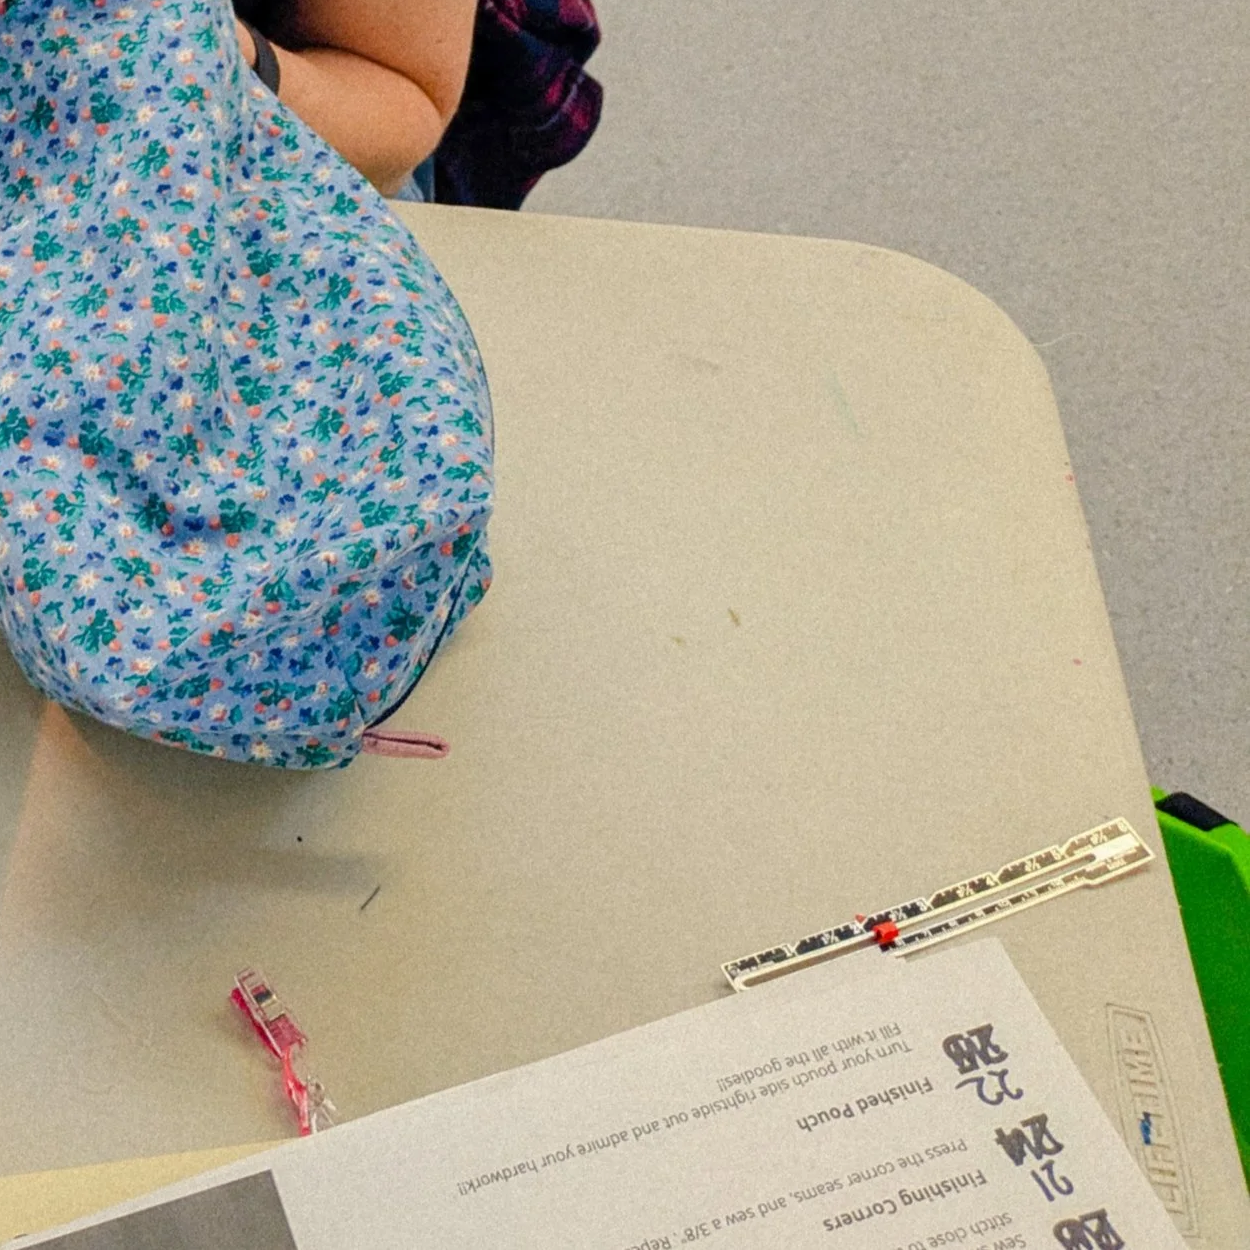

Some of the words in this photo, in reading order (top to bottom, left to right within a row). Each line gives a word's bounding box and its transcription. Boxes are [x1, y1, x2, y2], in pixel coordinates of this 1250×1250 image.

[864, 1029, 878, 1042] it
[878, 1022, 902, 1041] Fill
[811, 1044, 830, 1063] all
[831, 1034, 866, 1054] with
[875, 1040, 913, 1059] Turn
[784, 1051, 811, 1068] the
[841, 1047, 876, 1071] your
[715, 1057, 783, 1093] goodies!!
[791, 1059, 839, 1088] pouch
[758, 1078, 791, 1097] side
[855, 1076, 934, 1115] Finished
[955, 1068, 1024, 1107] 22
[690, 1089, 757, 1120] rightside
[661, 1111, 689, 1130] out
[796, 1102, 855, 1133] Pouch
[576, 1130, 629, 1156] admire
[631, 1120, 660, 1142] and
[541, 1143, 576, 1168] your
[896, 1152, 925, 1169] the
[924, 1138, 969, 1160] Press
[456, 1159, 539, 1196] hardwork!!
[847, 1161, 896, 1187] corner
[1030, 1159, 1075, 1203] 21
[788, 1178, 844, 1204] seams,
[897, 1169, 988, 1207] Finishing
[725, 1207, 756, 1226] sew
[757, 1196, 788, 1219] and
[822, 1199, 898, 1232] Corners
[711, 1218, 722, 1231] a
[969, 1212, 1013, 1237] stitch
[926, 1226, 968, 1249] close
